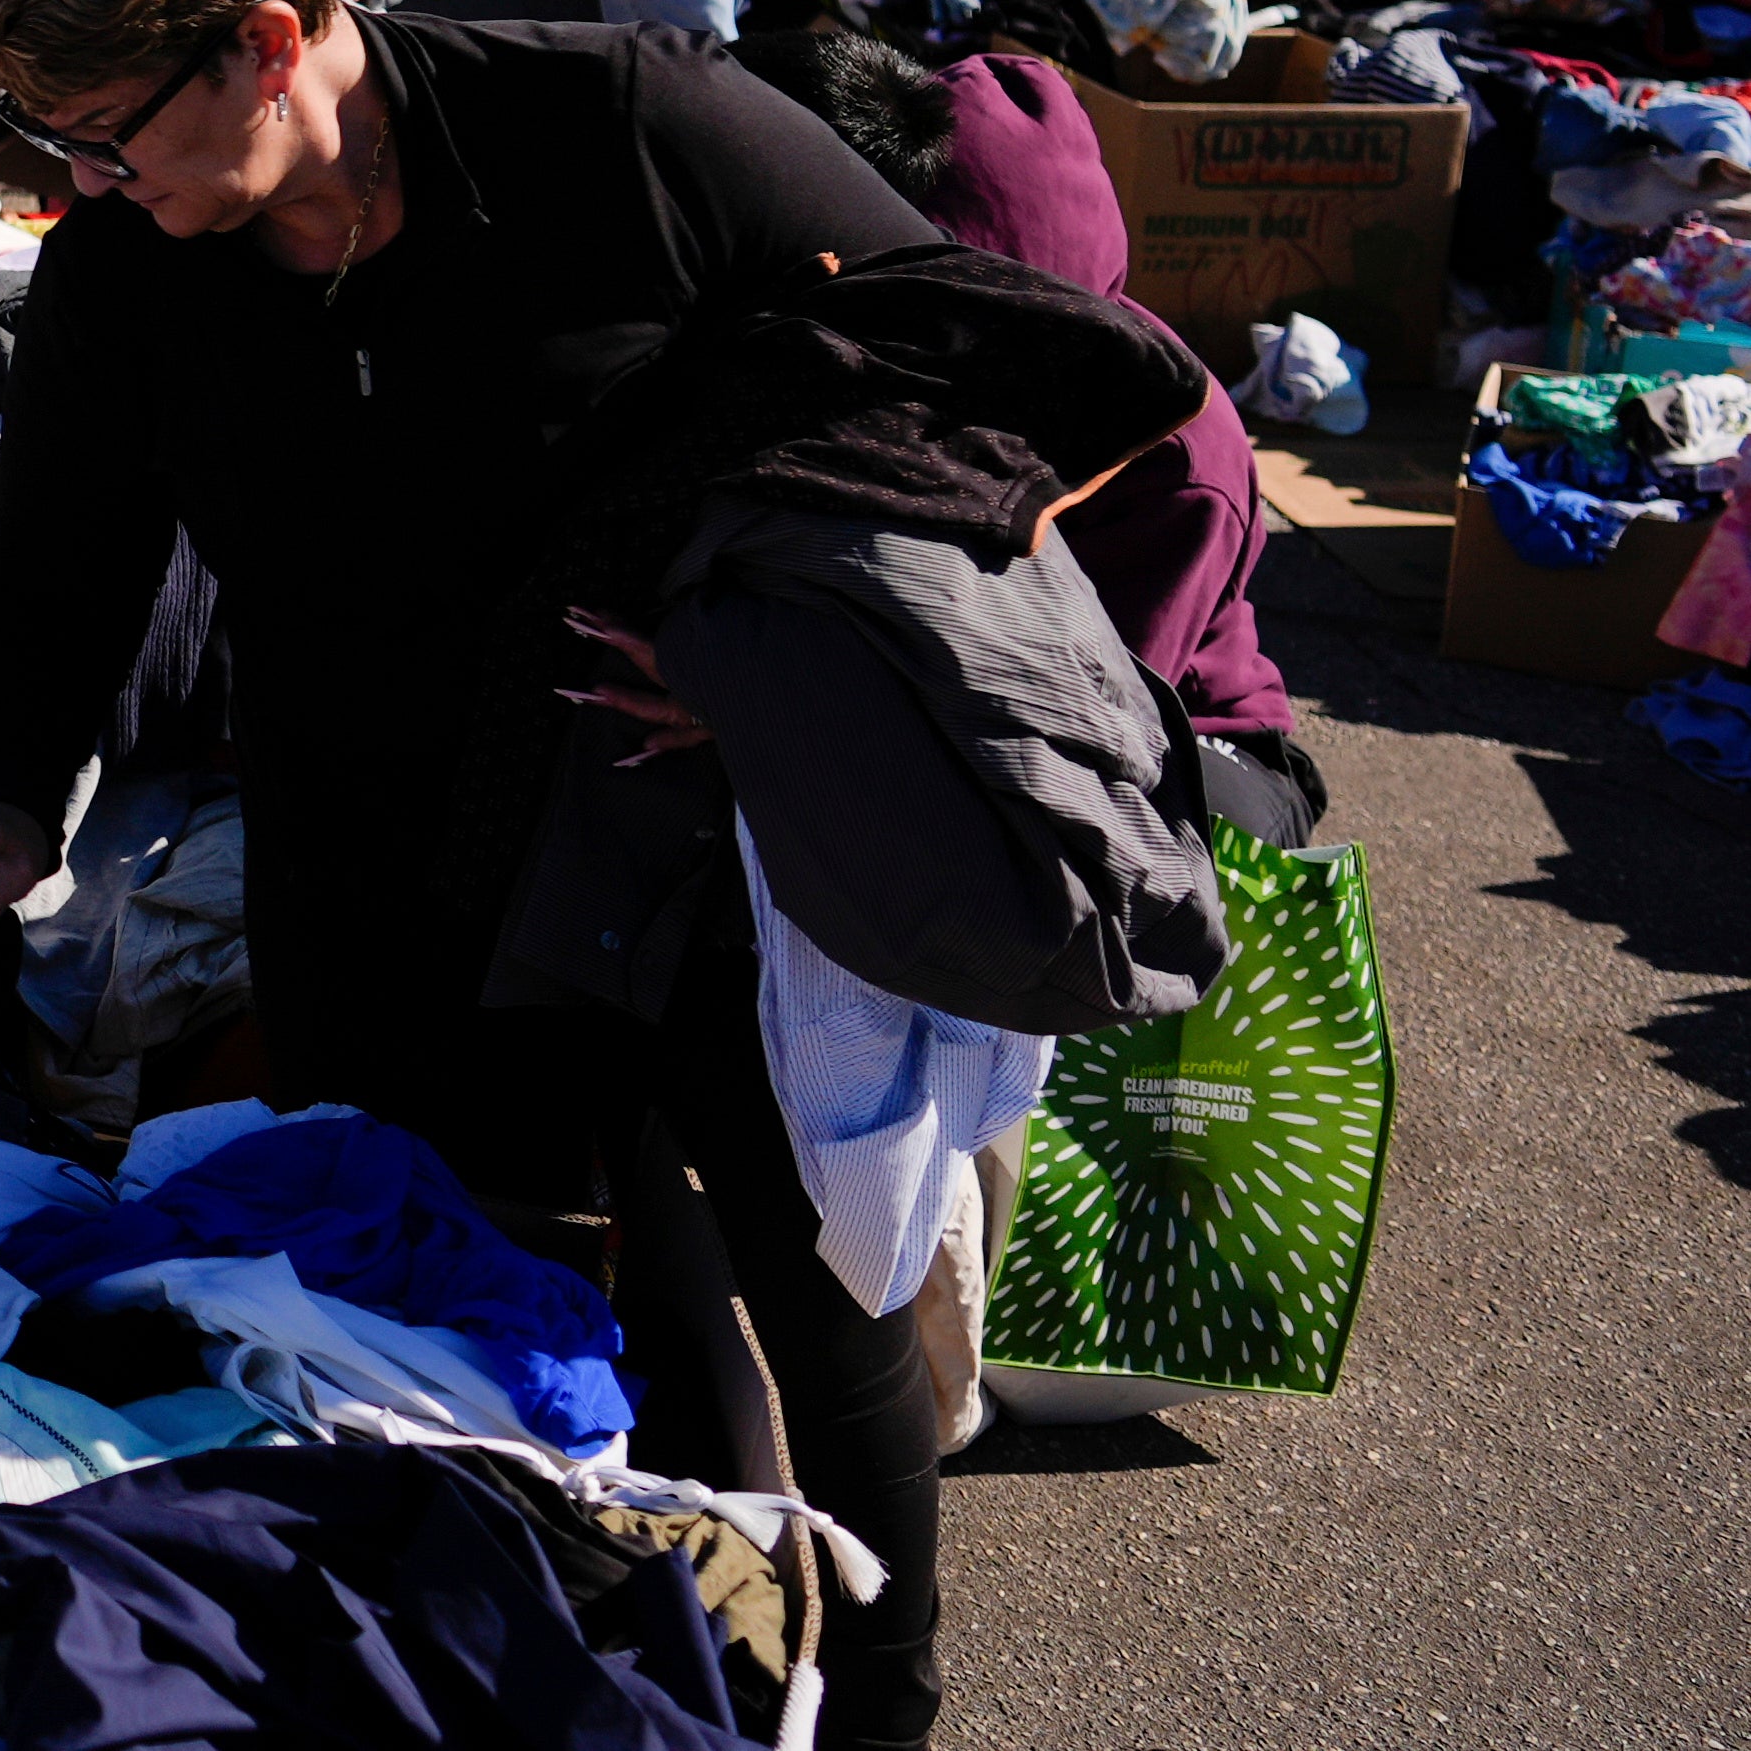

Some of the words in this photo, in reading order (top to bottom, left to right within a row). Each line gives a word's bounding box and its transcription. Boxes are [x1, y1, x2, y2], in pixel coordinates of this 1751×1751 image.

[1180, 1059, 1251, 1078] crafted!
[1123, 1077, 1163, 1094] CLEAN
[1124, 1097, 1173, 1114] FRESHLY
[1172, 1097, 1250, 1123] PREPARED
